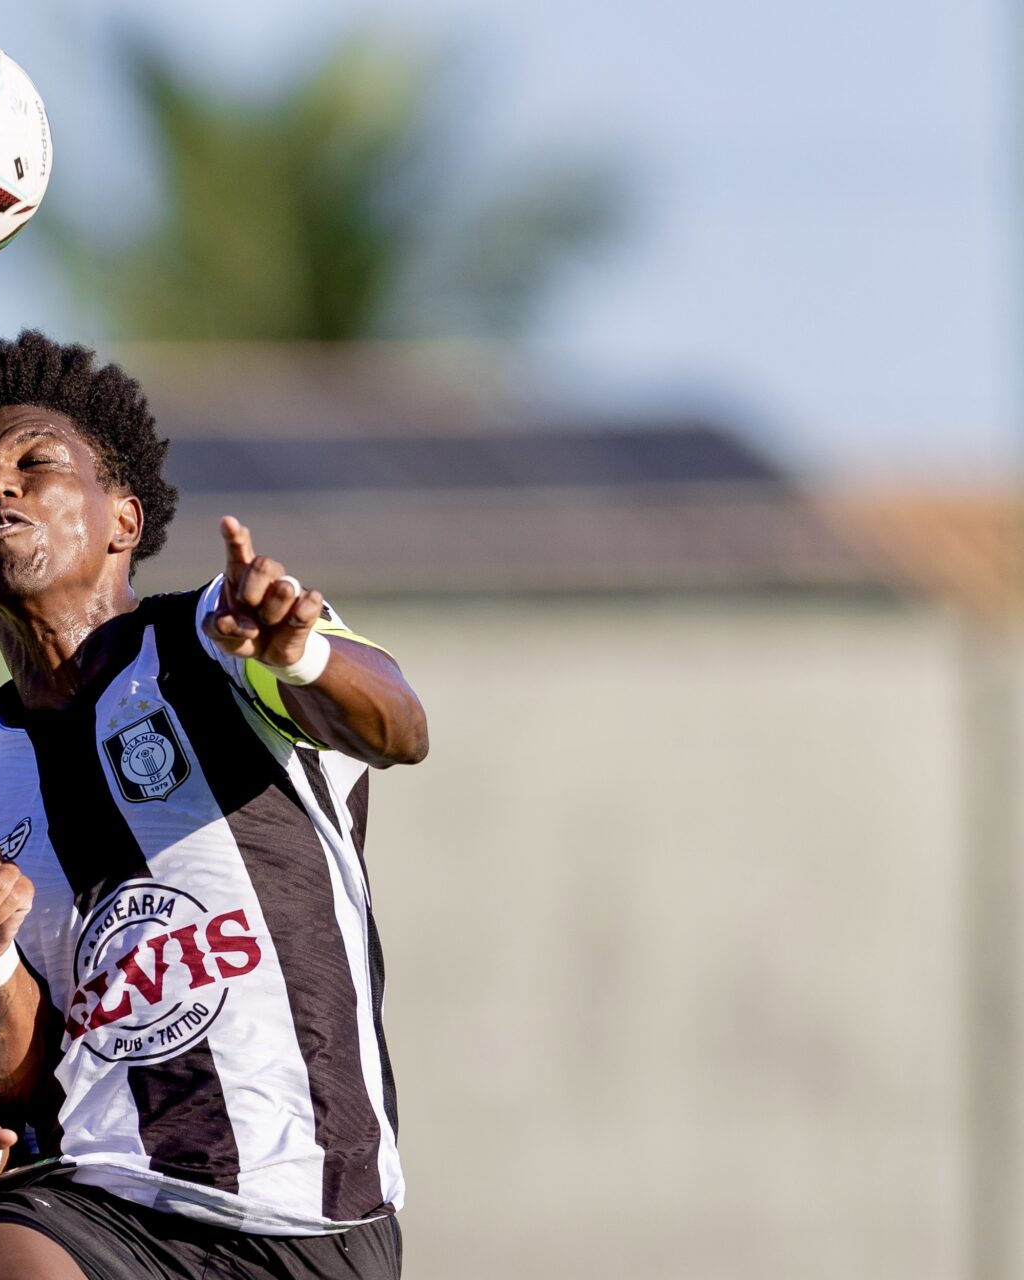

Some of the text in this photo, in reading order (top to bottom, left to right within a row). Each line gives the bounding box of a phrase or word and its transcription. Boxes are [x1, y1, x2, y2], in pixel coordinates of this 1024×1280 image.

[149, 772, 162, 783] DF
[150, 781, 169, 793] 1979
[113, 1002, 209, 1055] PUB TATTOO
